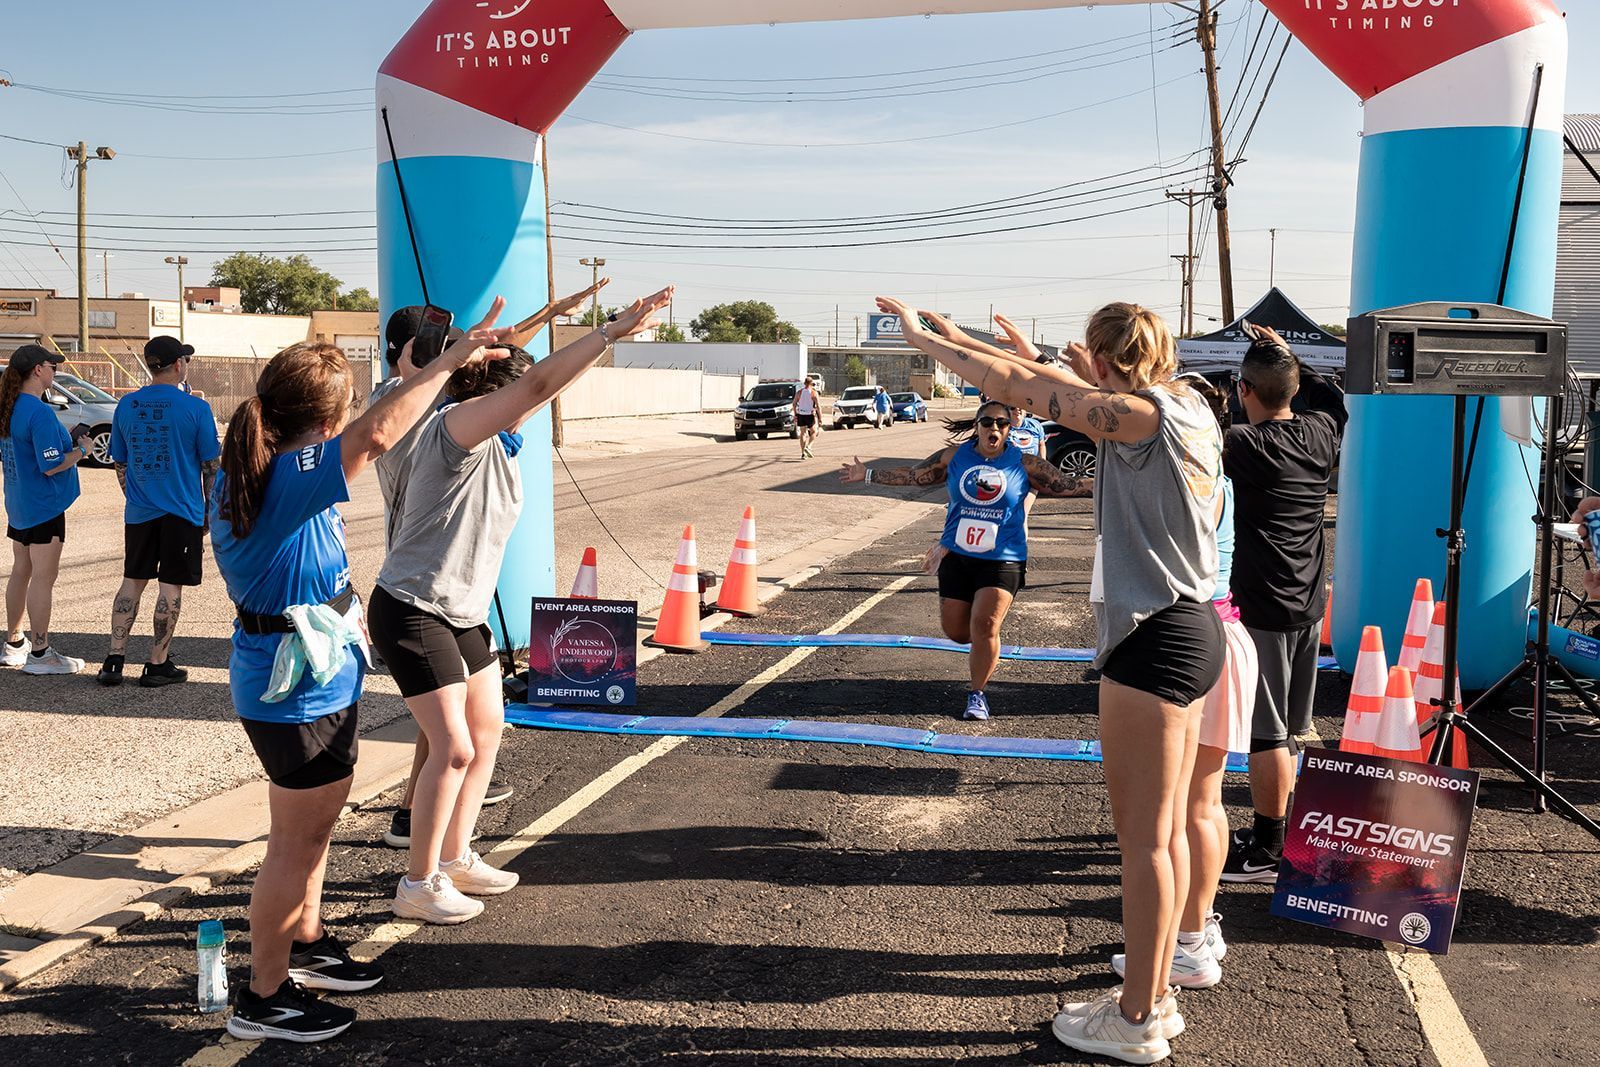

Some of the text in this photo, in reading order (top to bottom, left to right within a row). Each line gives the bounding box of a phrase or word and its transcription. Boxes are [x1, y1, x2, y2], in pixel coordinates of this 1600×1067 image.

[1304, 0, 1349, 11] ITS
[1329, 14, 1434, 30] TIMING
[436, 26, 571, 52] IT'S ABOUT
[457, 53, 549, 68] TIMING
[43, 449, 60, 458] HUB
[966, 526, 986, 545] 67
[535, 603, 634, 614] EVENT AREA SPONSOR
[567, 639, 605, 647] VANESSA
[559, 648, 613, 657] UNDERWOOD
[537, 688, 600, 698] BENEFITTING
[1307, 757, 1471, 793] EVENT AREA SPONSOR
[1299, 811, 1455, 856] FASTSIGNS
[1305, 834, 1436, 869] Make Your Statement
[1286, 894, 1389, 927] BENEFITTING
